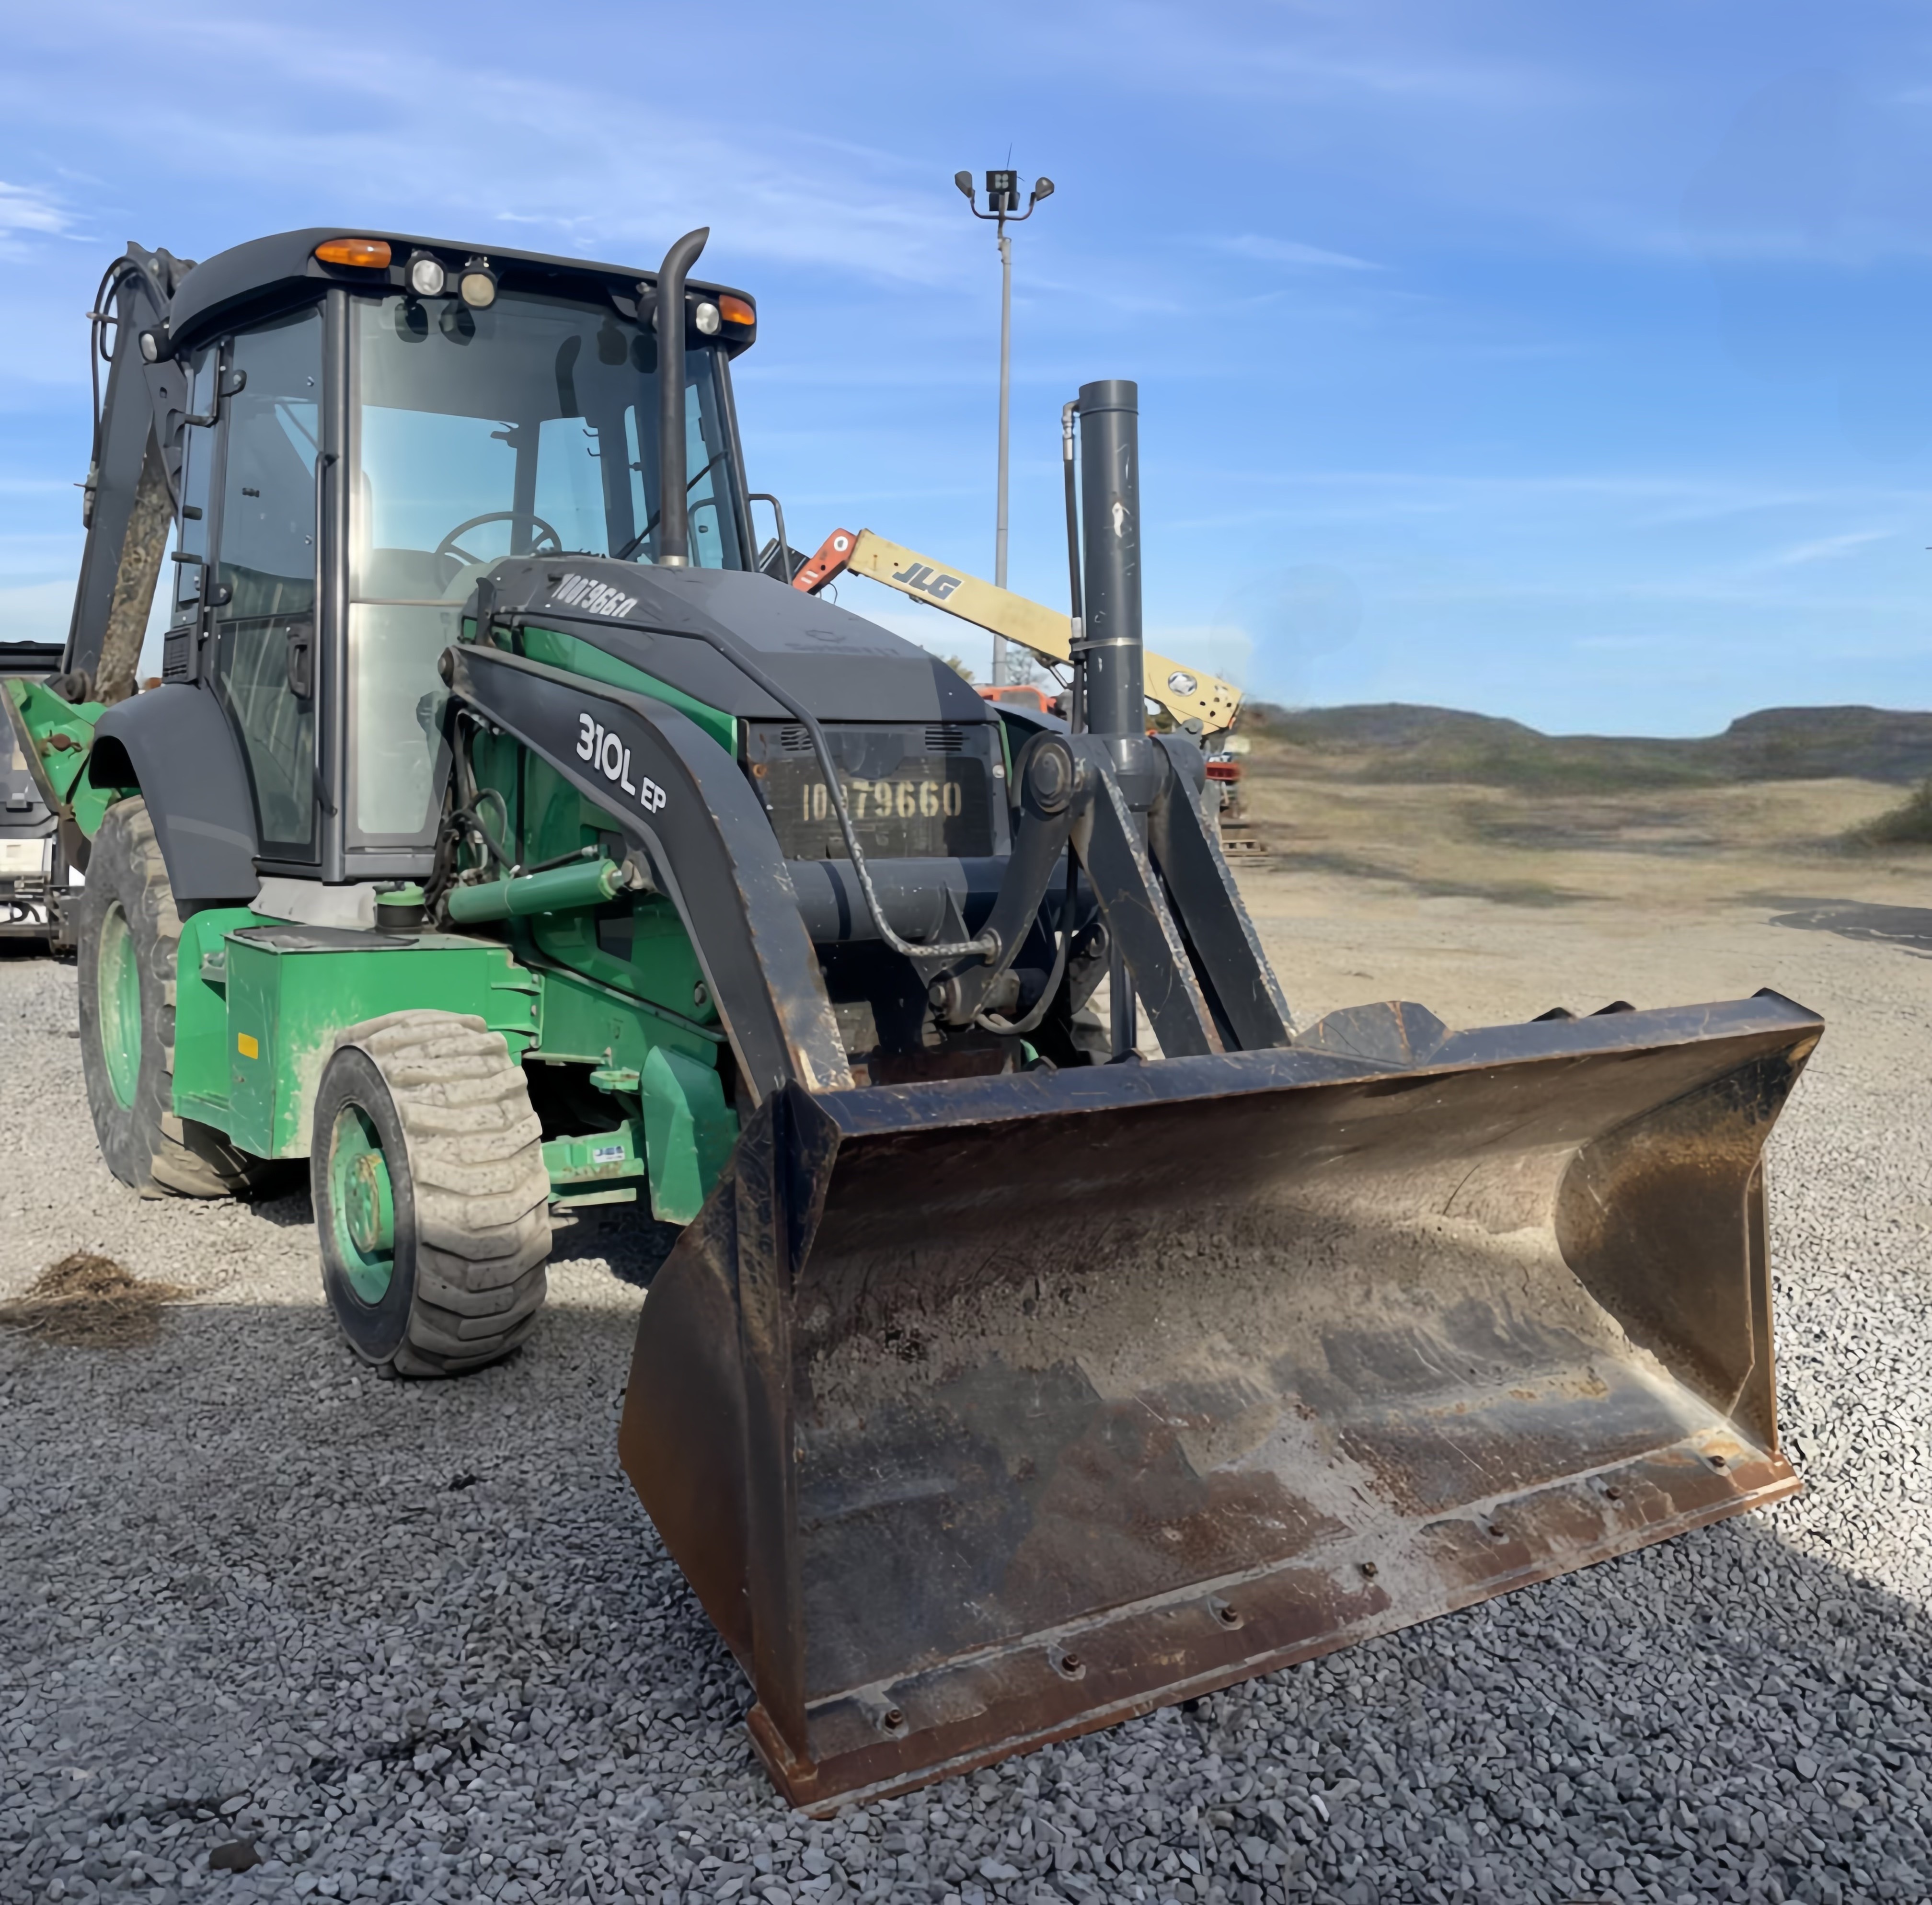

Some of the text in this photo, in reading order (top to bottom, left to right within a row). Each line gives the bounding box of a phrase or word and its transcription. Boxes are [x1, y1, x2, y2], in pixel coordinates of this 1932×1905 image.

[892, 562, 963, 600] JLG
[576, 713, 667, 814] 310L EP
